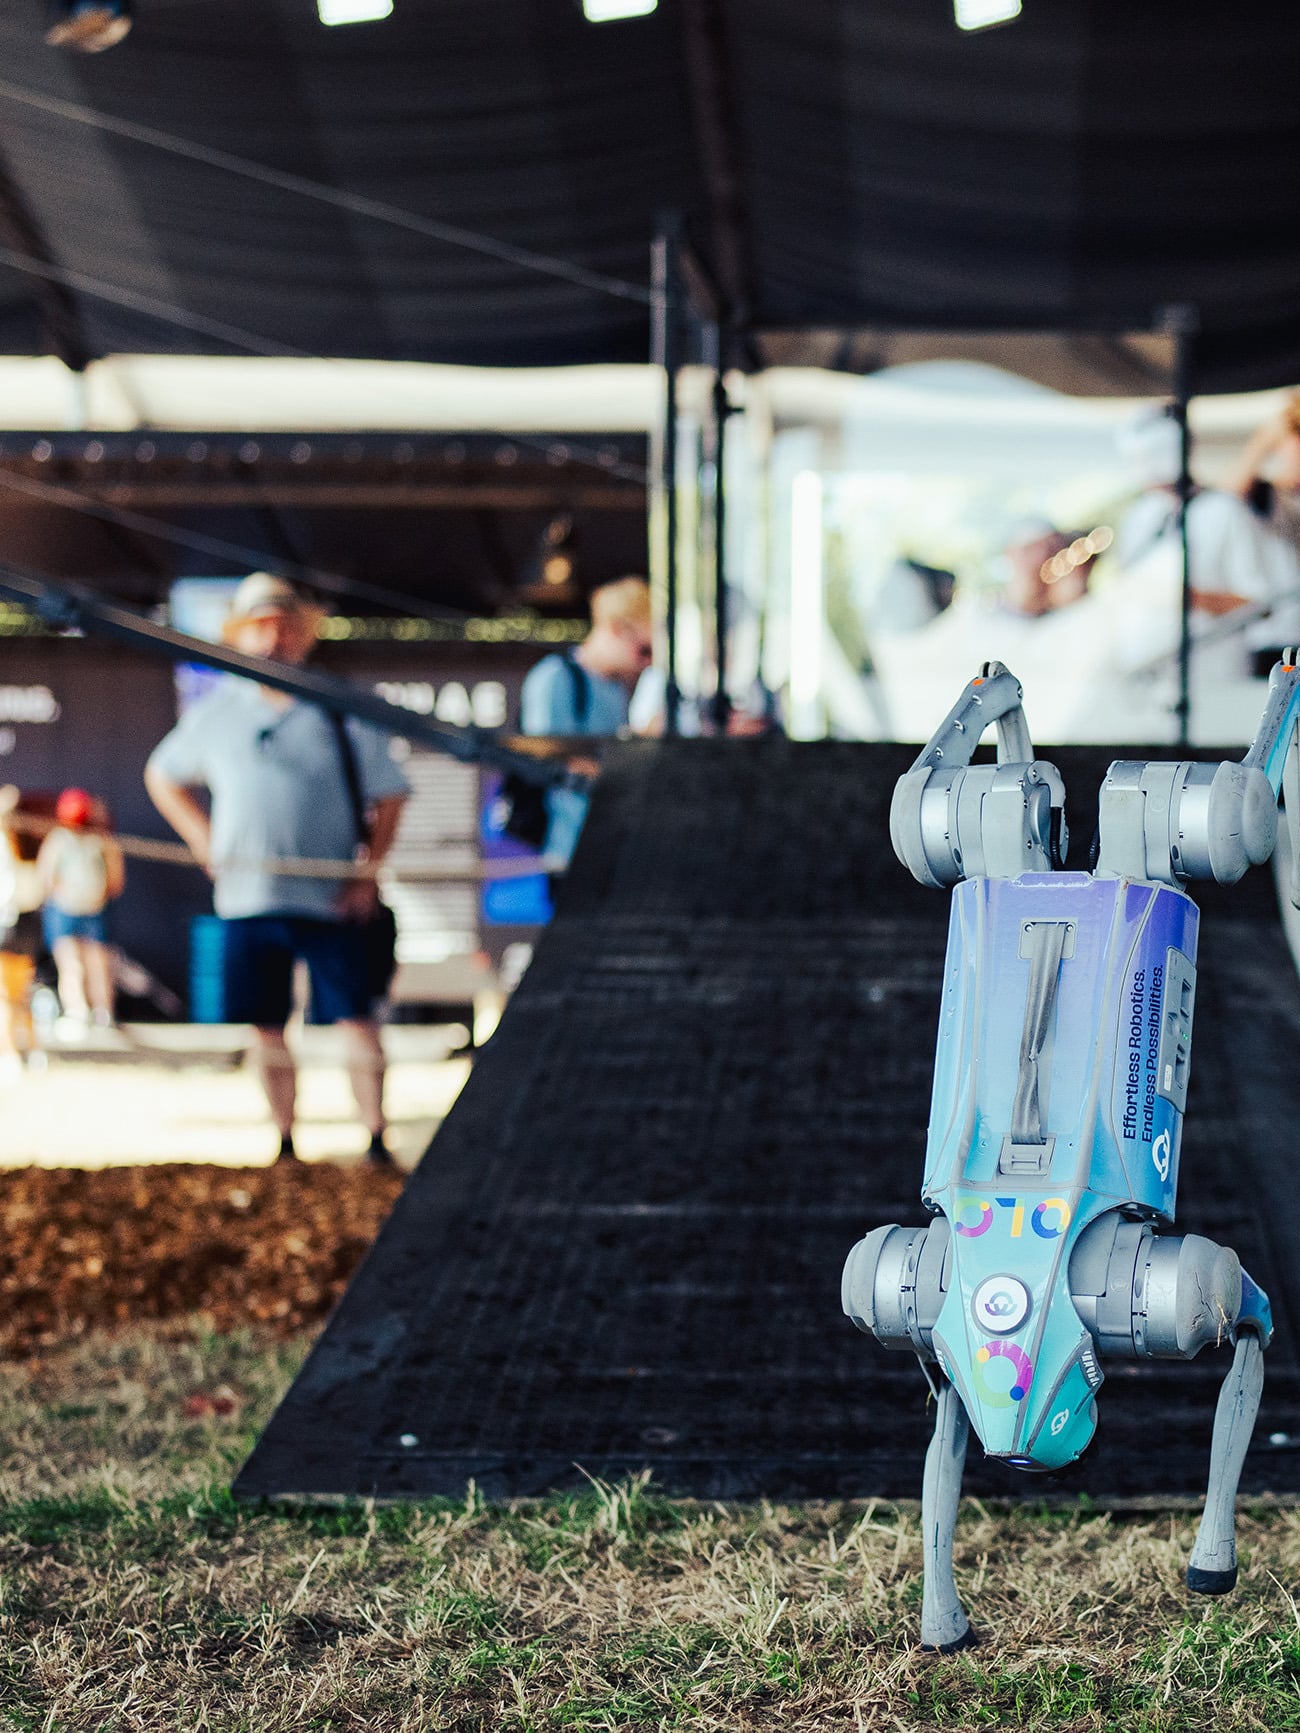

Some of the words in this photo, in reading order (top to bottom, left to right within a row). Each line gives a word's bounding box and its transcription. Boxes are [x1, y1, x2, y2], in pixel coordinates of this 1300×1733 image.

[1129, 968, 1146, 1048] Robotics.
[1146, 964, 1163, 1070] Possibilities.
[1123, 1052, 1141, 1140] Effortless
[1142, 1074, 1157, 1143] Endless
